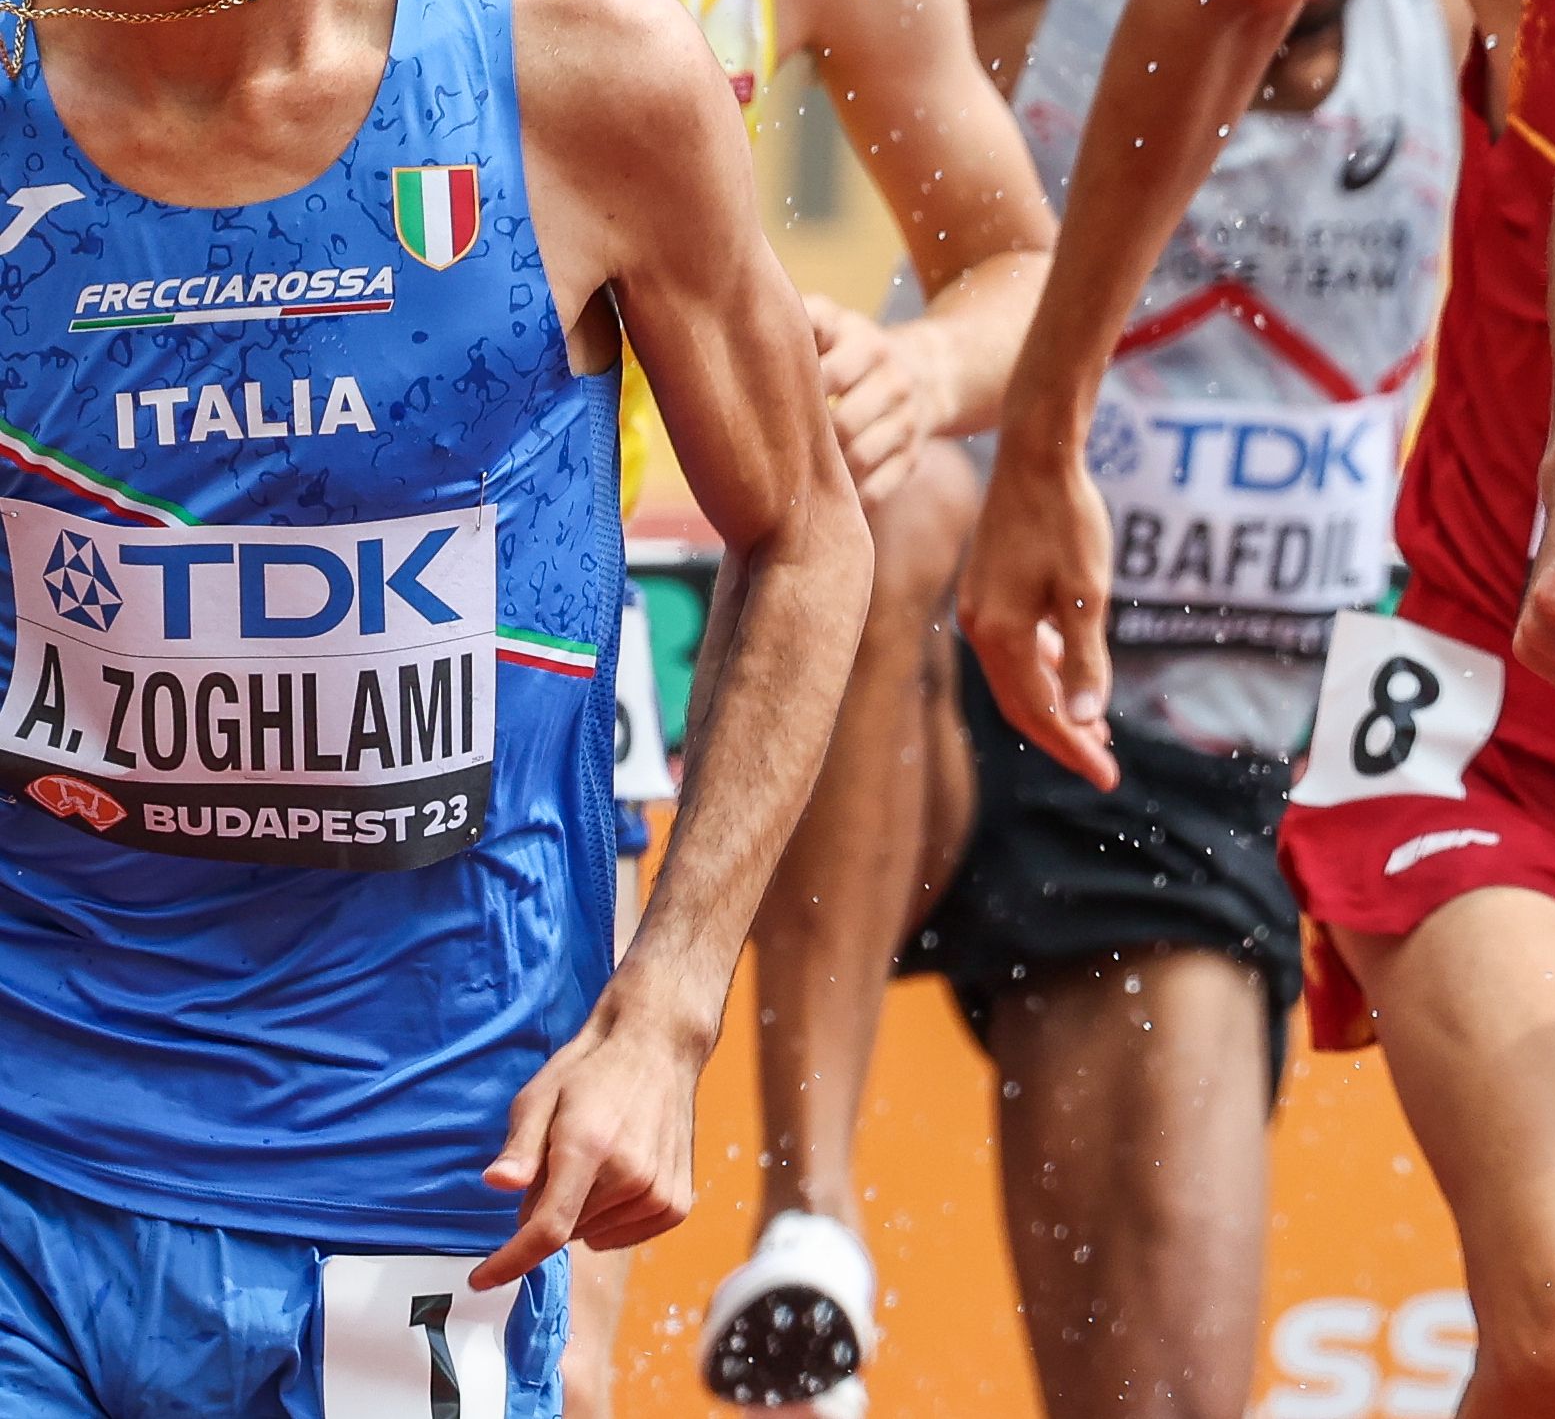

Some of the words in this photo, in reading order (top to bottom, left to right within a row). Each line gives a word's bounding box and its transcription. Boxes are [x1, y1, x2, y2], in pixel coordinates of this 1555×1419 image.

[75, 266, 394, 314] FRECCIAROSSA
[115, 377, 377, 450] ITALIA
[1152, 418, 1370, 493] TDK
[119, 526, 463, 640] TDK
[16, 643, 82, 755] A.
[102, 652, 475, 774] ZOGHLAMI
[1352, 655, 1440, 778] 8
[143, 800, 416, 846] BUDAPEST
[421, 795, 468, 835] 23
[408, 1291, 462, 1419] 1
